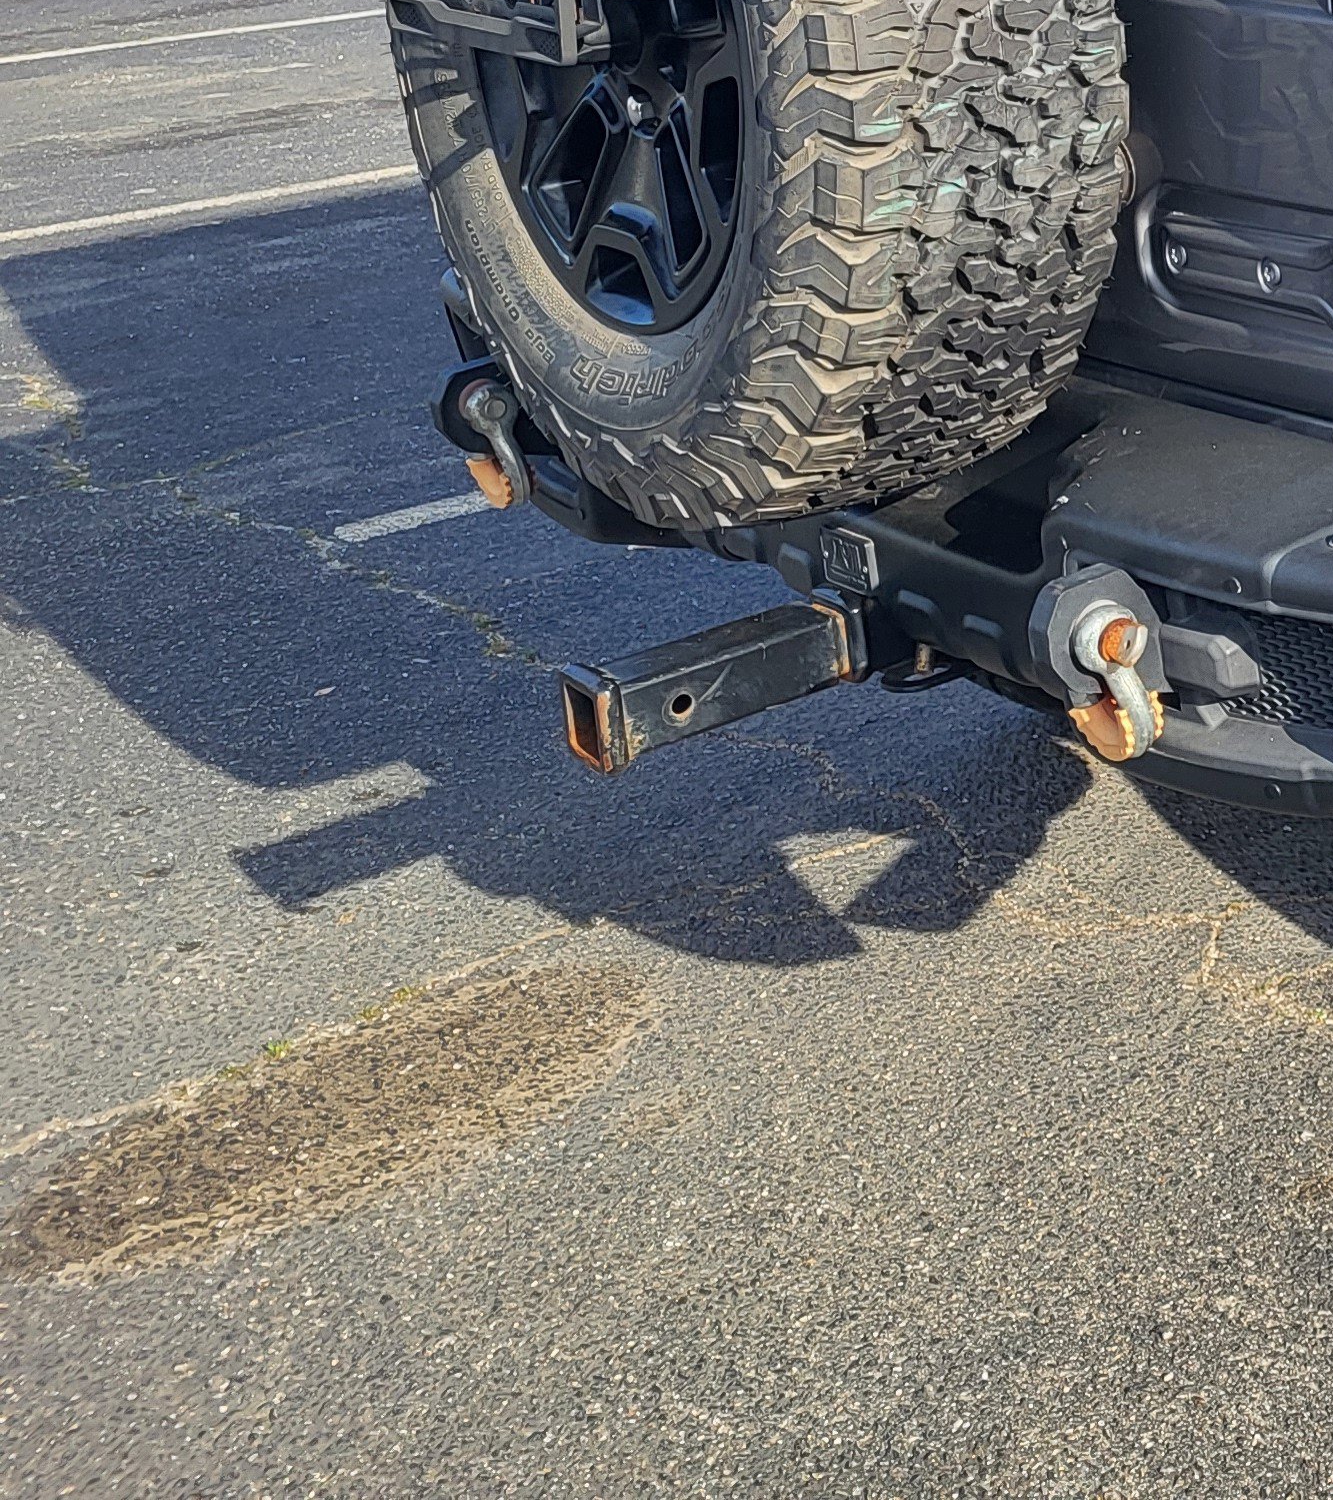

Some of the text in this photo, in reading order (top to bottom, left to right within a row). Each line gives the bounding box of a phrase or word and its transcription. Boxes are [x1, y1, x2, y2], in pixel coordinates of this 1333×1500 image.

[487, 173, 508, 210] LOAD
[464, 218, 521, 324] Champion
[524, 328, 556, 364] Baja
